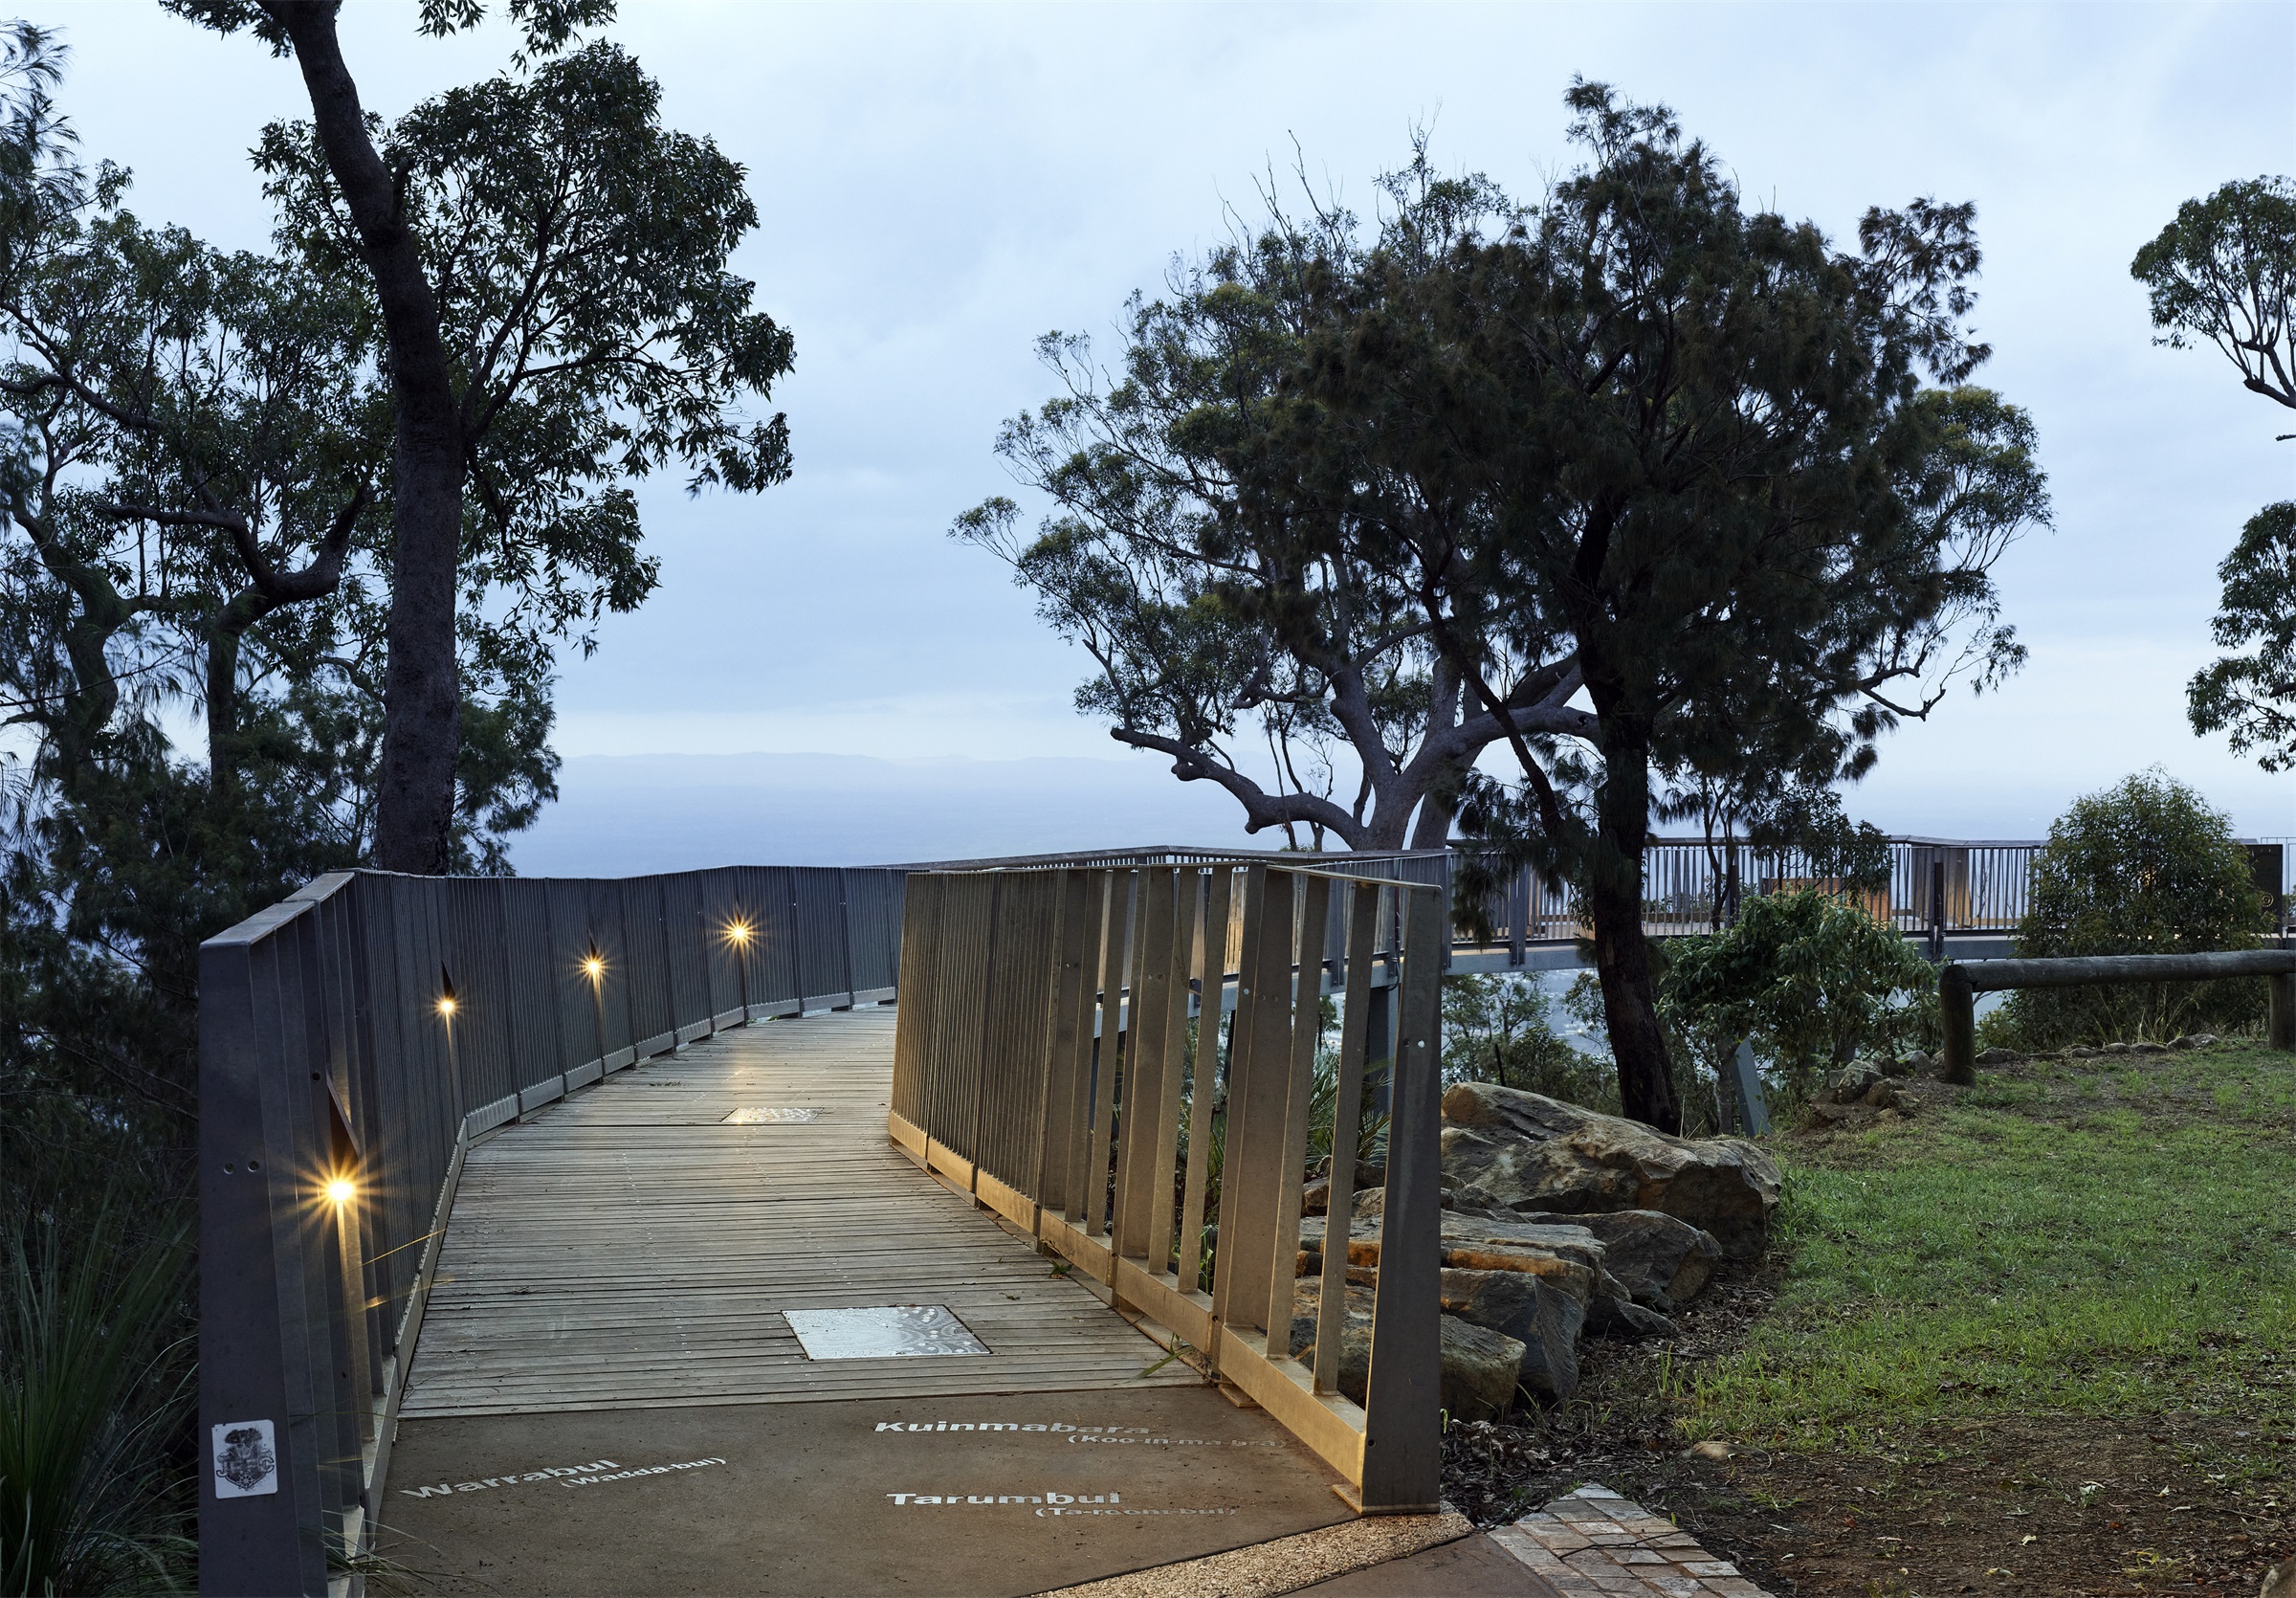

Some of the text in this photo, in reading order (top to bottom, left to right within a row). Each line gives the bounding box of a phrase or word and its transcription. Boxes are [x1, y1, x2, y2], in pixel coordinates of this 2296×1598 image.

[873, 1421, 1150, 1434] Kuinmabara
[399, 1459, 621, 1499] Warrabul
[886, 1492, 1120, 1505] Tarumbul
